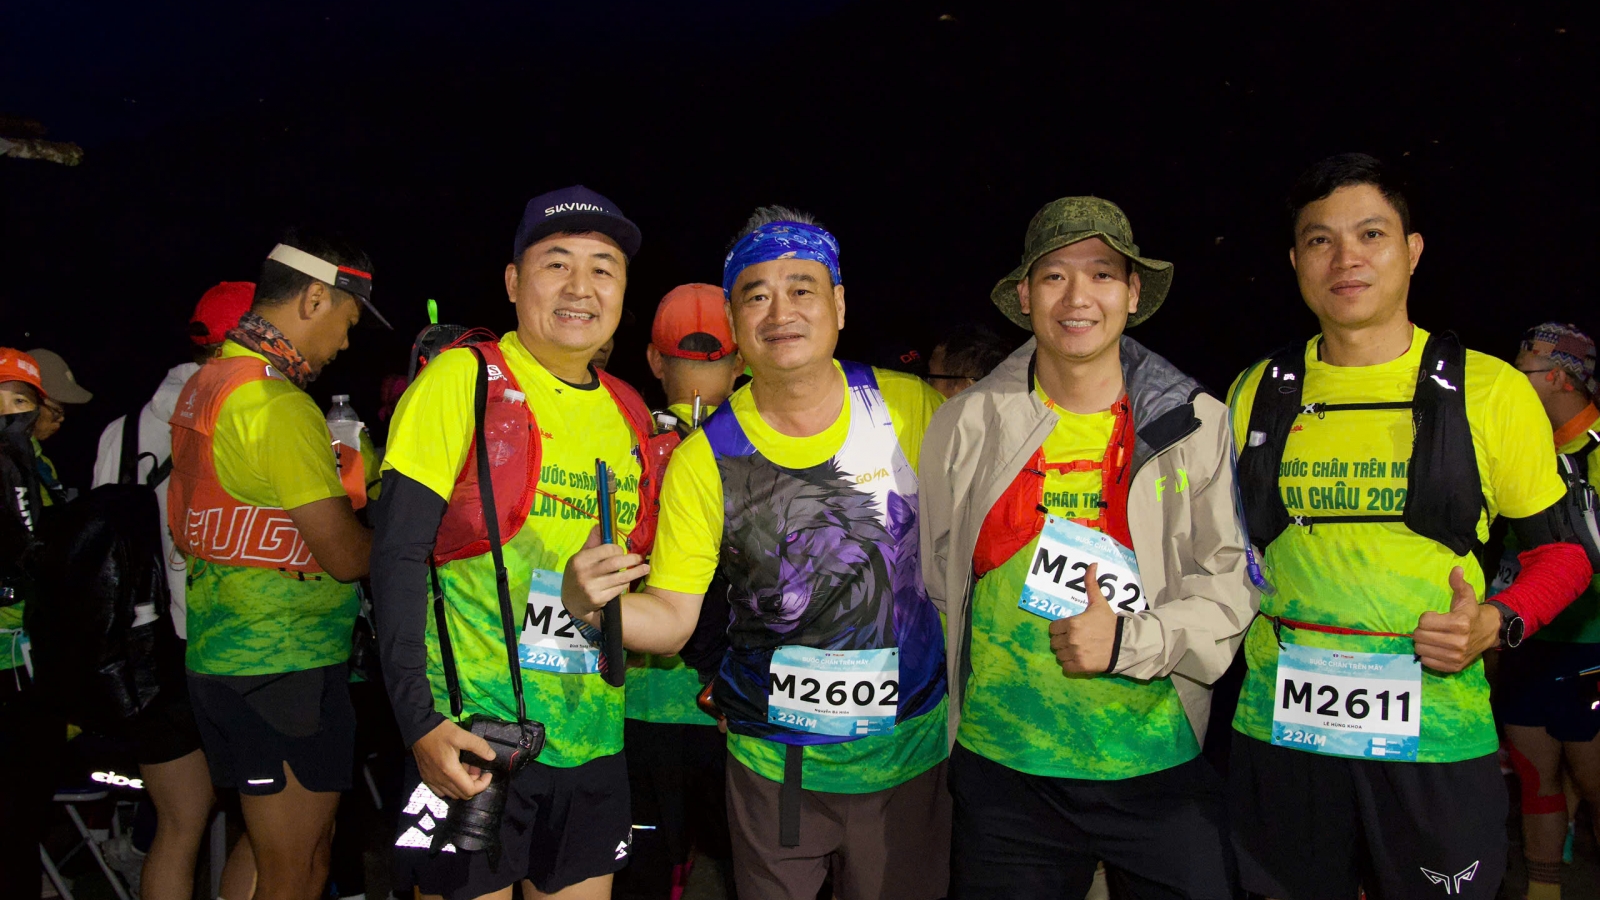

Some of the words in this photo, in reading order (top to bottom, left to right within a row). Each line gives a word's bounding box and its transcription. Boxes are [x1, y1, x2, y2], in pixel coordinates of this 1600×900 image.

[540, 463, 566, 486] ƯỚC
[1312, 457, 1348, 478] CHÂN
[1353, 457, 1386, 478] TRÊN
[1044, 491, 1078, 508] CHÂN
[1083, 492, 1102, 508] TR
[1308, 480, 1360, 510] CHÂU
[1367, 487, 1408, 512] 202
[1032, 547, 1150, 613] M262
[1028, 596, 1073, 618] 22KM
[522, 602, 575, 638] M2
[526, 652, 569, 667] 22KM
[768, 672, 900, 707] M2602
[1282, 678, 1410, 722] M2611
[778, 711, 818, 729] 22KM
[1282, 728, 1327, 747] 22KM
